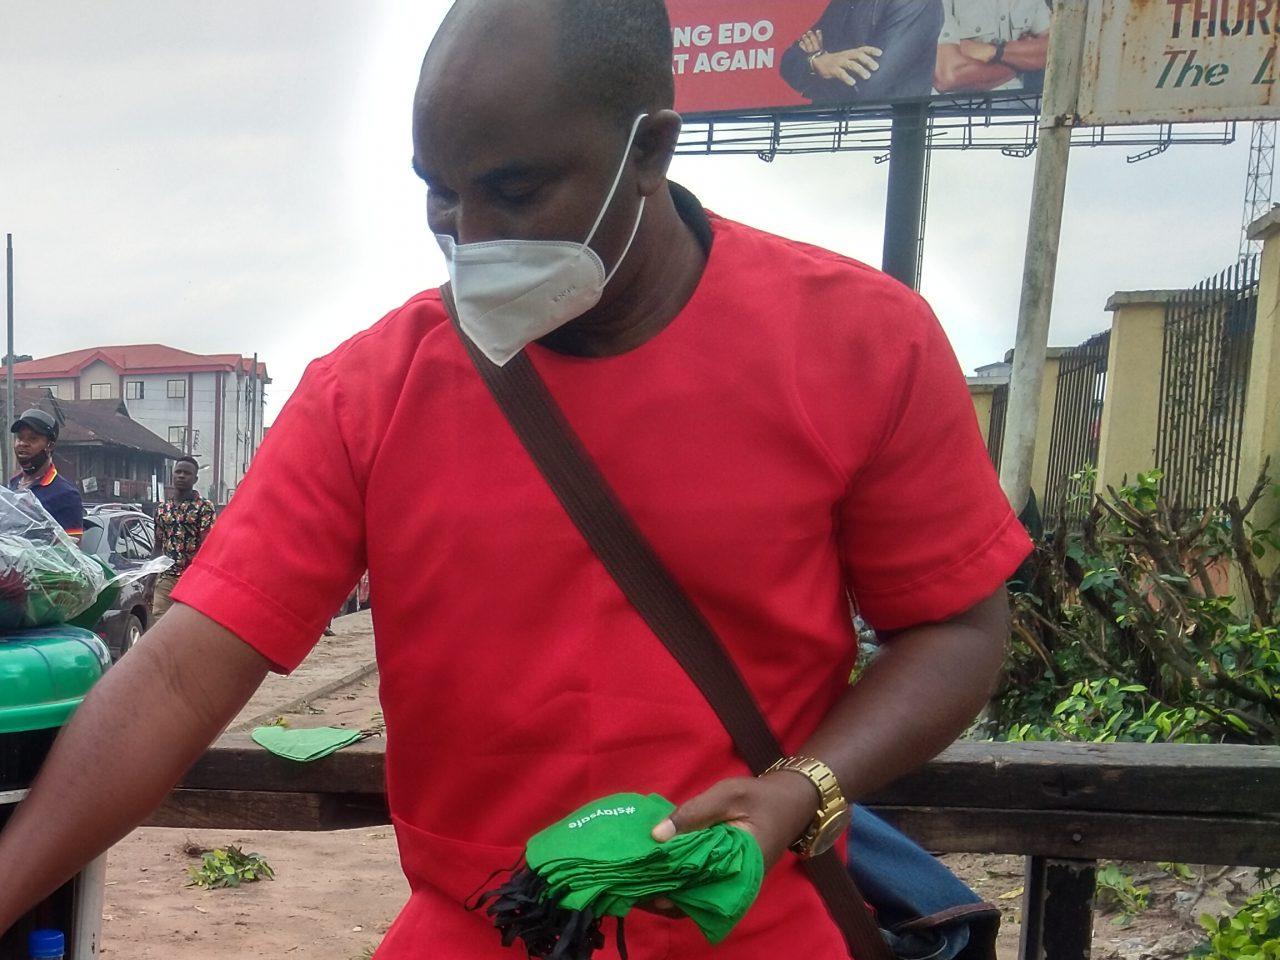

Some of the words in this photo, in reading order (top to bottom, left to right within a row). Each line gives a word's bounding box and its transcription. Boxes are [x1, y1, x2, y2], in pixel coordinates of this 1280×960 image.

[718, 20, 774, 45] EDO
[672, 53, 689, 75] T
[693, 48, 775, 74] AGAIN
[1155, 50, 1229, 88] The
[568, 806, 636, 829] #staysafe
